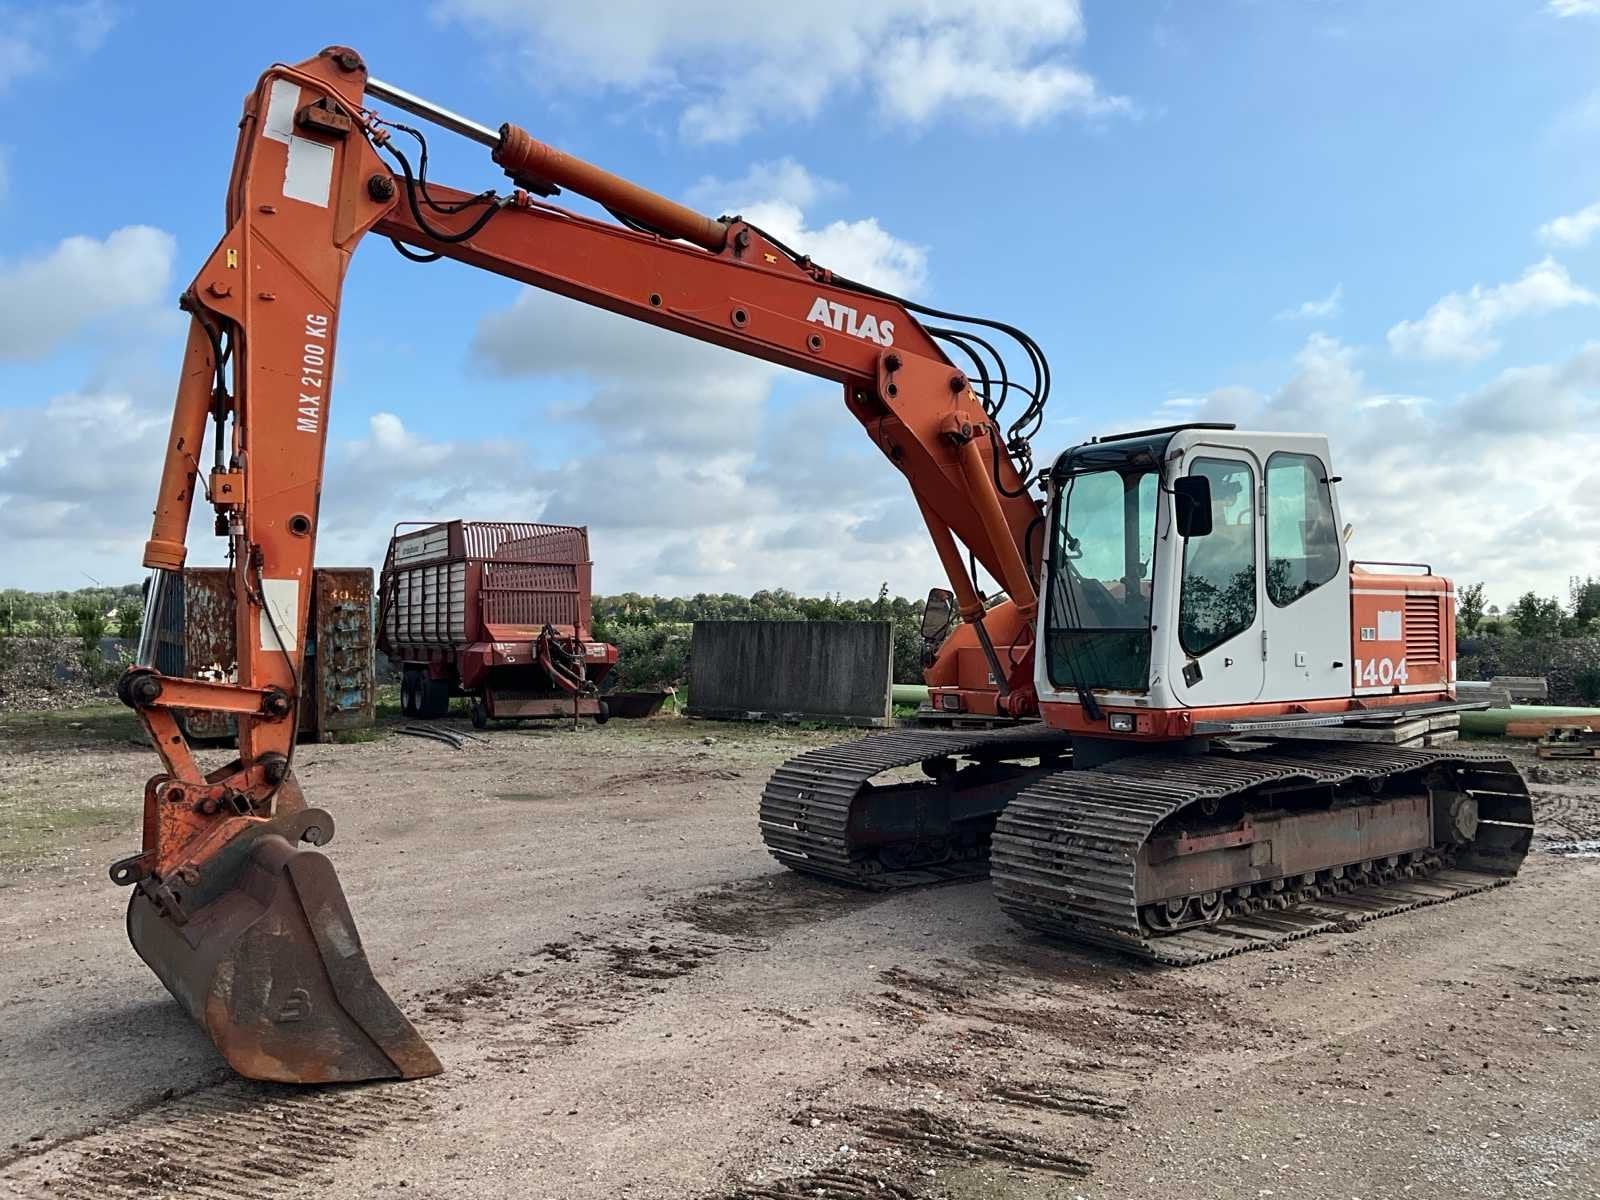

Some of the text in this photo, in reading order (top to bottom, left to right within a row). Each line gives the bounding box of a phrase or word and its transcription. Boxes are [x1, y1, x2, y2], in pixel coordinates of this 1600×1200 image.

[806, 297, 894, 347] ATLAS
[297, 314, 328, 433] MAX 2100 KG
[1355, 658, 1408, 686] 1404
